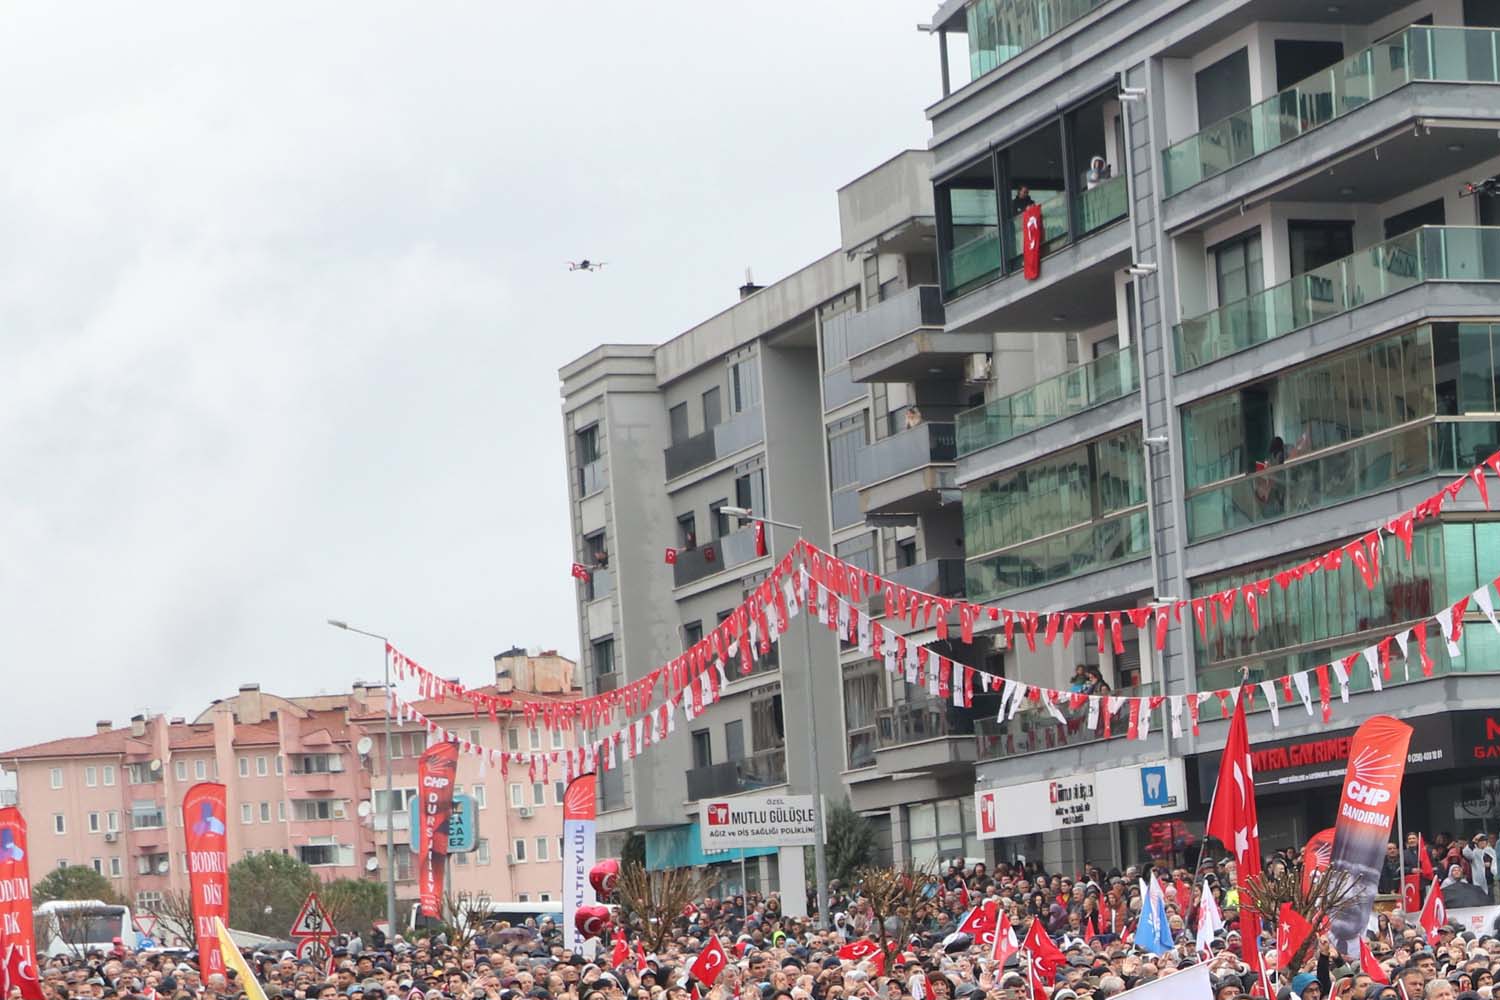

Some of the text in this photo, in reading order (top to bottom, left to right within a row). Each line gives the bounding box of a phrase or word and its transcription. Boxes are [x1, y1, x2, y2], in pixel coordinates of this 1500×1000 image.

[424, 776, 449, 789] CHP
[1347, 780, 1391, 807] CHP
[732, 808, 767, 825] MUTLU
[1342, 803, 1390, 828] BANDIRMA
[709, 828, 727, 838] AĞIZ
[737, 827, 750, 838] DİŞ
[751, 826, 779, 837] SAĞLIĞI
